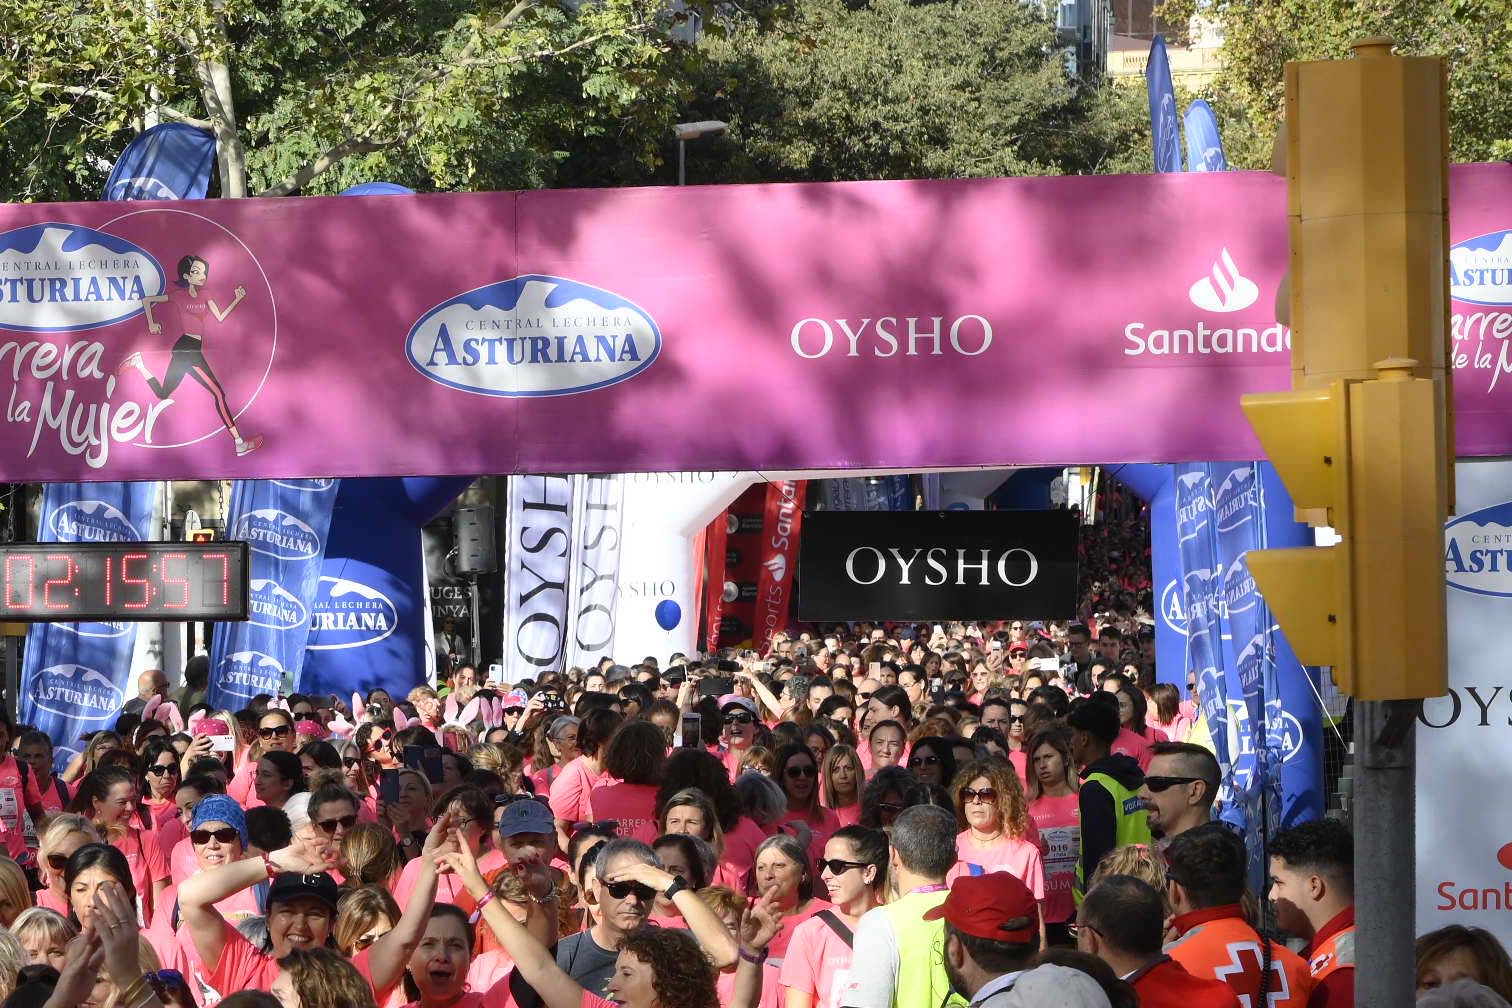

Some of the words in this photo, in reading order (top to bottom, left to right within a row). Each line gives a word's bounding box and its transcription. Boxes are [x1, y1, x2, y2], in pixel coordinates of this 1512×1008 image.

[67, 258, 141, 271] LECHERA
[464, 318, 544, 331] CENTRAL
[551, 316, 633, 328] LECHERA
[789, 313, 994, 359] OYSHO
[425, 322, 642, 367] ASTURIANA
[1474, 340, 1492, 370] la
[6, 384, 33, 424] la
[25, 374, 176, 469] Mujer
[237, 520, 314, 555] ASTURIANA
[6, 553, 229, 609] 02:15:57
[844, 546, 1039, 587] OYSHO
[334, 600, 385, 610] LECHERA
[34, 678, 117, 712] ASTURIANA
